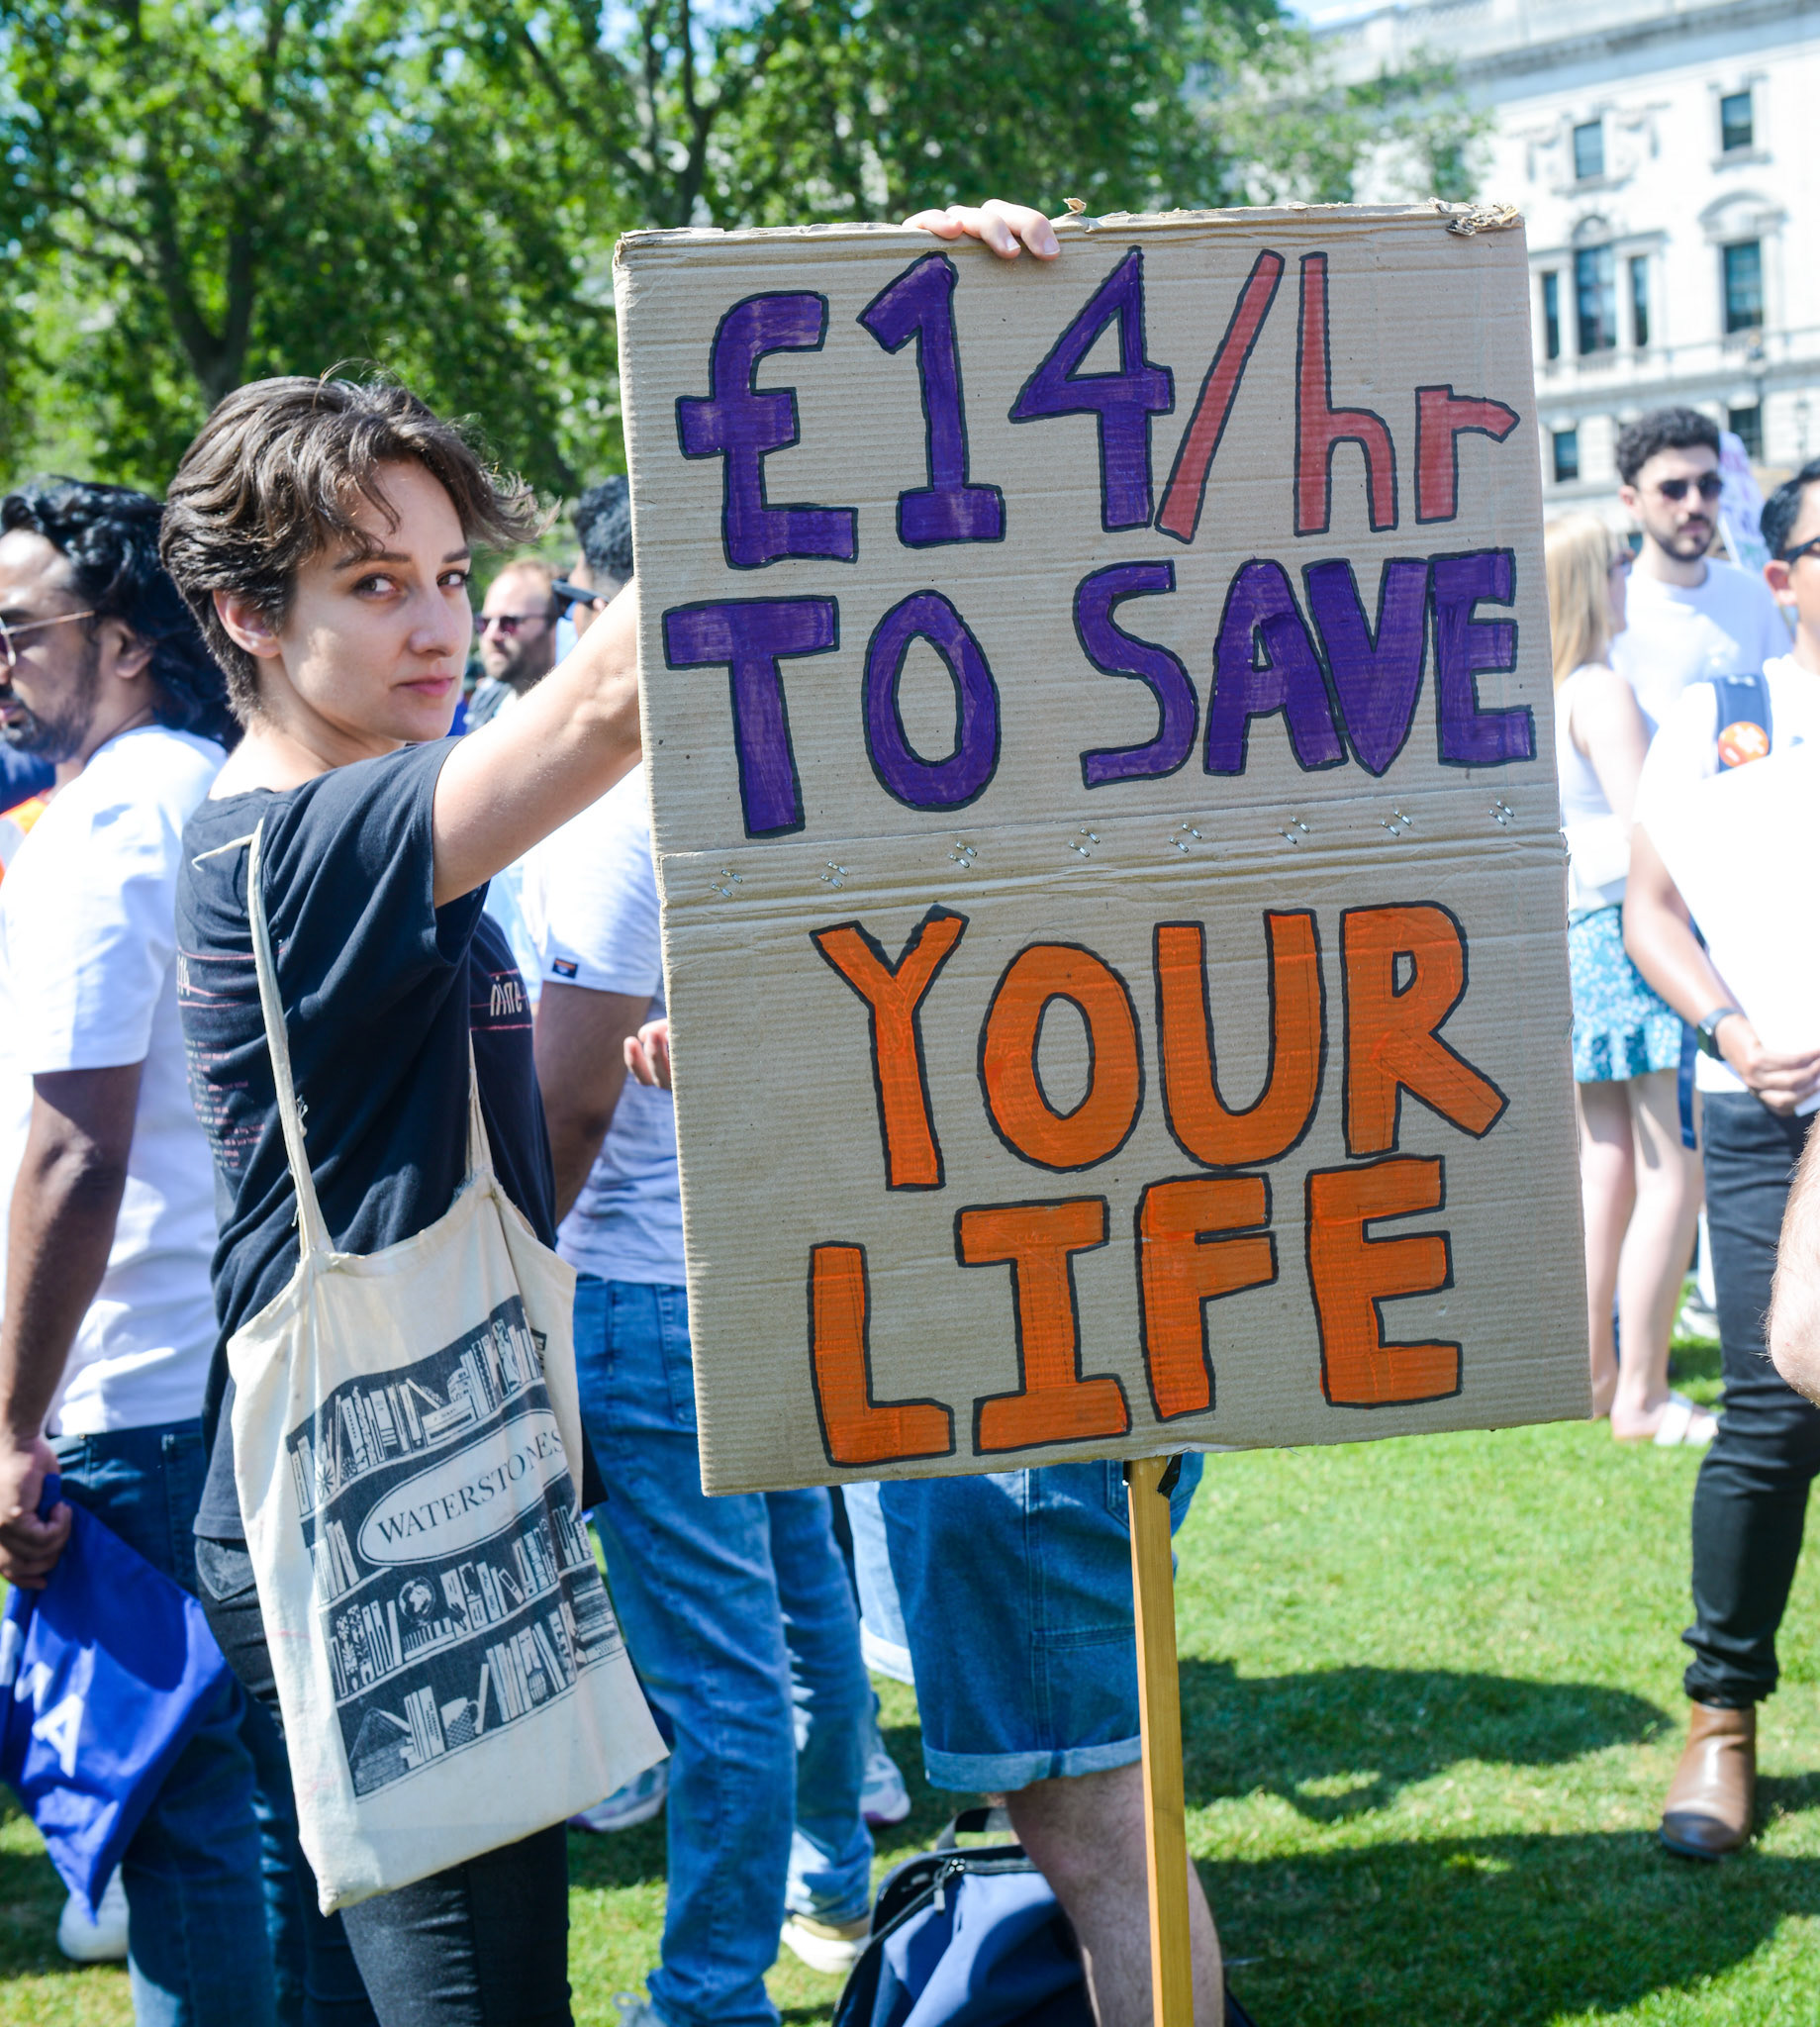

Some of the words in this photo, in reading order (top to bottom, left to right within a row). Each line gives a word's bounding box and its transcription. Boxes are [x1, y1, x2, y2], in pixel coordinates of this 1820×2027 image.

[675, 245, 1521, 570] £14/hr
[662, 589, 1001, 840] TO
[1073, 546, 1538, 789] SAVE
[810, 900, 1510, 1192] YOUR
[808, 1154, 1464, 1467] LIFE
[375, 1428, 565, 1544] WATERSTONES
